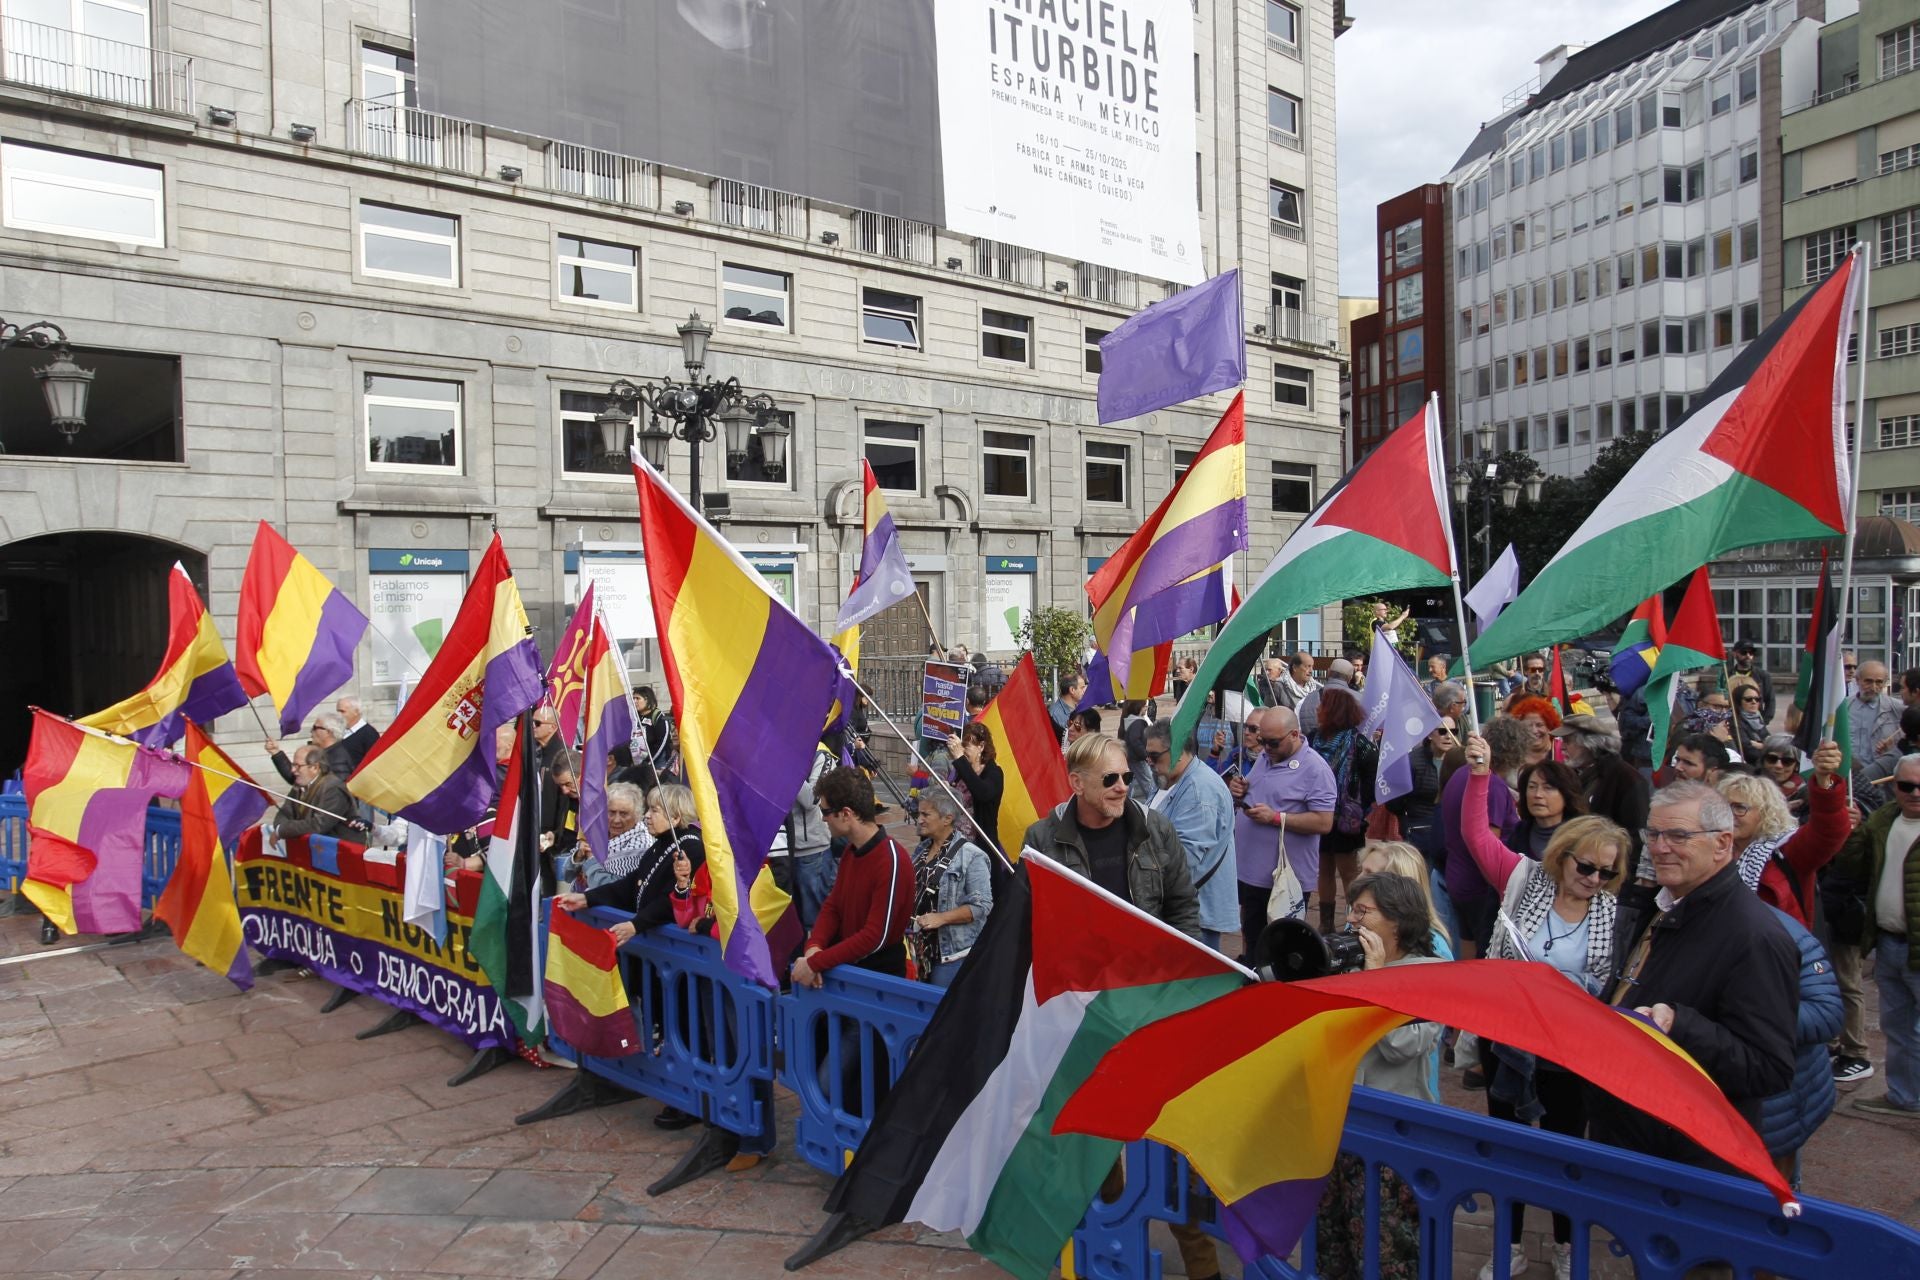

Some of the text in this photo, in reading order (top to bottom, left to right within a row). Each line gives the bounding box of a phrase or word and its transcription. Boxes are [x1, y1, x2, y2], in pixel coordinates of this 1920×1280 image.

[994, 0, 1159, 64] ACIELA
[989, 7, 1159, 114] ITURBIDE
[991, 62, 1159, 138] ESPAÑA Y MÉXICO
[991, 88, 1017, 106] PREMIO
[1021, 98, 1052, 117] PRINCESA
[1055, 110, 1064, 121] DE
[1100, 125, 1108, 136] DE
[1111, 129, 1122, 141] LAS
[1125, 134, 1143, 147] ARTES
[1085, 148, 1128, 170] 25/10/2025
[1033, 163, 1053, 178] NAVE
[1097, 182, 1132, 202] (OVIEDO)
[1055, 154, 1065, 167] DE
[1071, 159, 1095, 176] ARMAS
[1100, 168, 1108, 180] DE
[1113, 173, 1122, 185] LA
[1127, 176, 1144, 191] VEGA
[413, 557, 443, 567] Unicaja
[373, 579, 430, 590] Hablamos
[373, 591, 424, 602] el mismo
[374, 603, 412, 613] idioma
[935, 680, 954, 691] hasta
[937, 689, 950, 697] que
[926, 705, 960, 720] vayan
[244, 866, 345, 925] FRENTE
